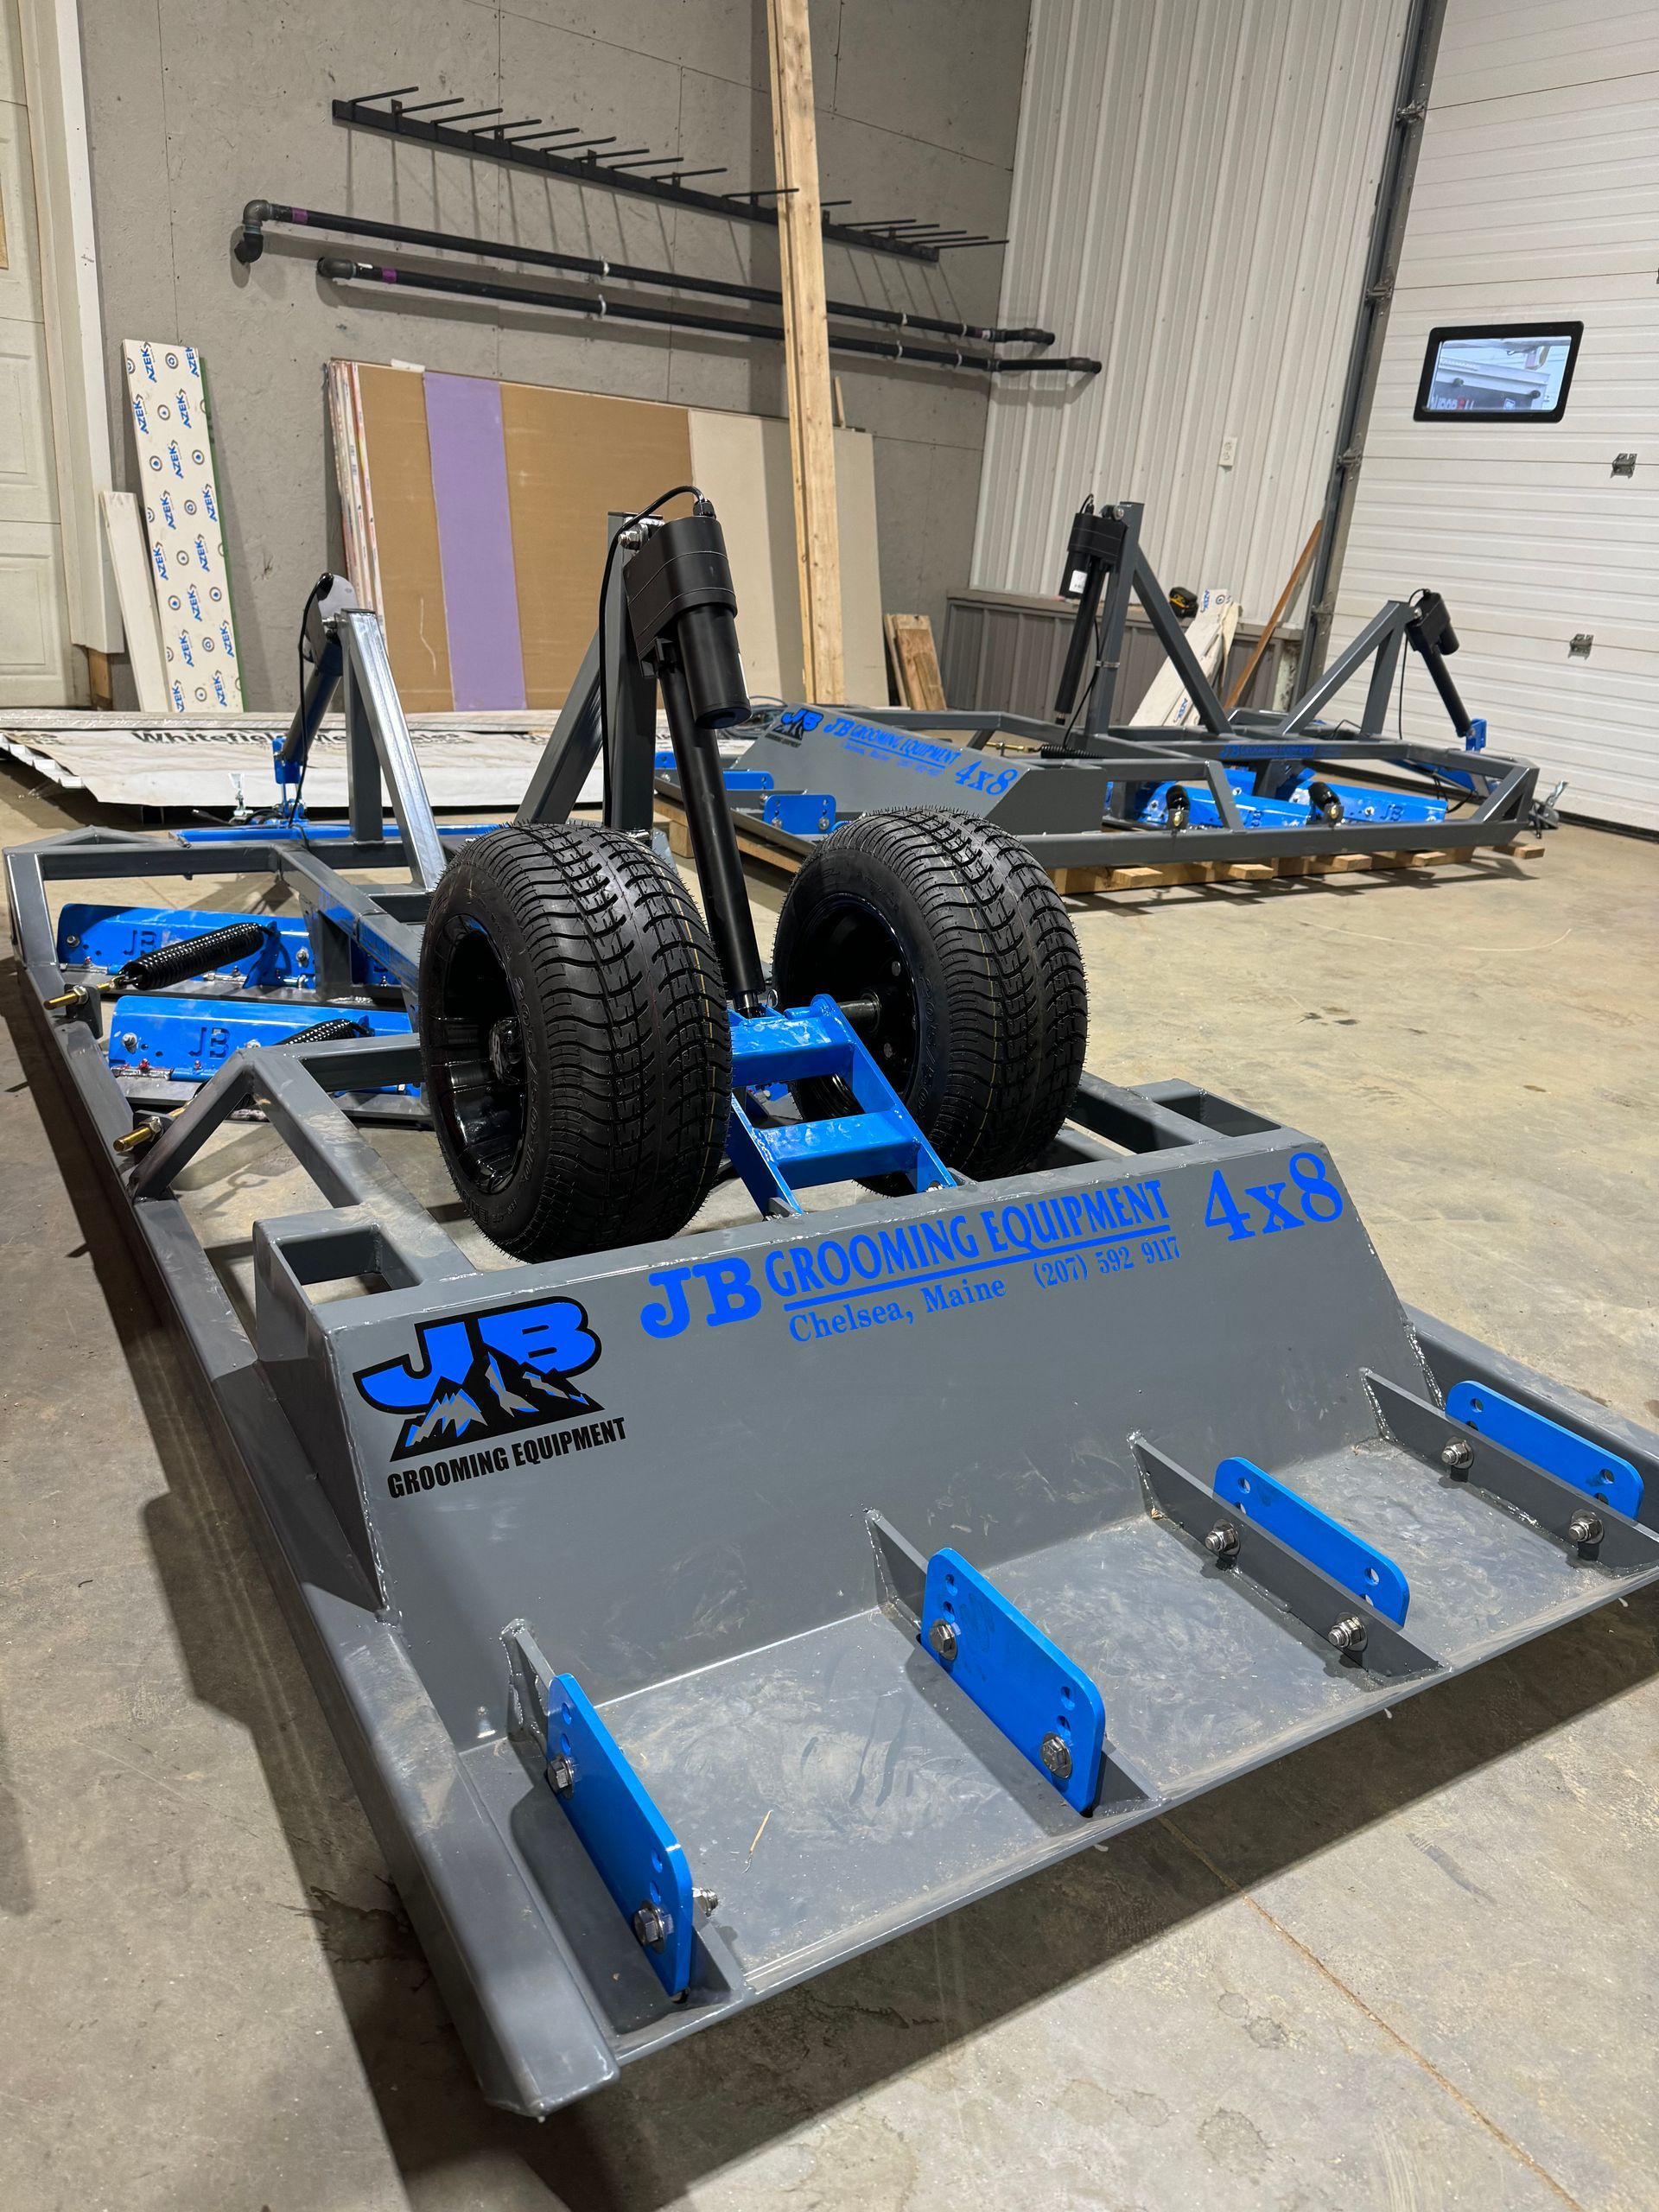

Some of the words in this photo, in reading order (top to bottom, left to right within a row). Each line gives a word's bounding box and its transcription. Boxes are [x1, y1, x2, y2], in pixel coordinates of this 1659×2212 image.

[141, 347, 157, 383] AZEK
[133, 400, 149, 435] AZEK
[176, 394, 192, 429] AZEK
[168, 446, 184, 480] AZEK
[161, 497, 176, 530] AZEK
[202, 490, 218, 523] AZEK
[153, 548, 168, 581] AZEK
[194, 540, 210, 572] AZEK
[188, 590, 203, 622] AZEK
[179, 635, 194, 668] AZEK
[219, 626, 235, 658] AZEK
[213, 676, 228, 708] AZEK
[780, 708, 823, 732] JB
[823, 718, 855, 737] JB
[955, 760, 1019, 796] 4x8
[188, 1026, 231, 1059] JB
[640, 1258, 762, 1339] JB
[765, 1217, 980, 1297] GROOMING
[980, 1179, 1171, 1258] EQUIPMENT
[1205, 1152, 1344, 1243] 4x8
[789, 1303, 914, 1342] Chelsea,
[921, 1281, 1006, 1313] Maine
[1033, 1254, 1088, 1289] (207)
[1098, 1247, 1134, 1274] 592
[1141, 1236, 1180, 1264] 9117
[353, 1296, 602, 1415] JB
[387, 1446, 510, 1499] GROOMING
[512, 1416, 626, 1467] EQUIPMENT
